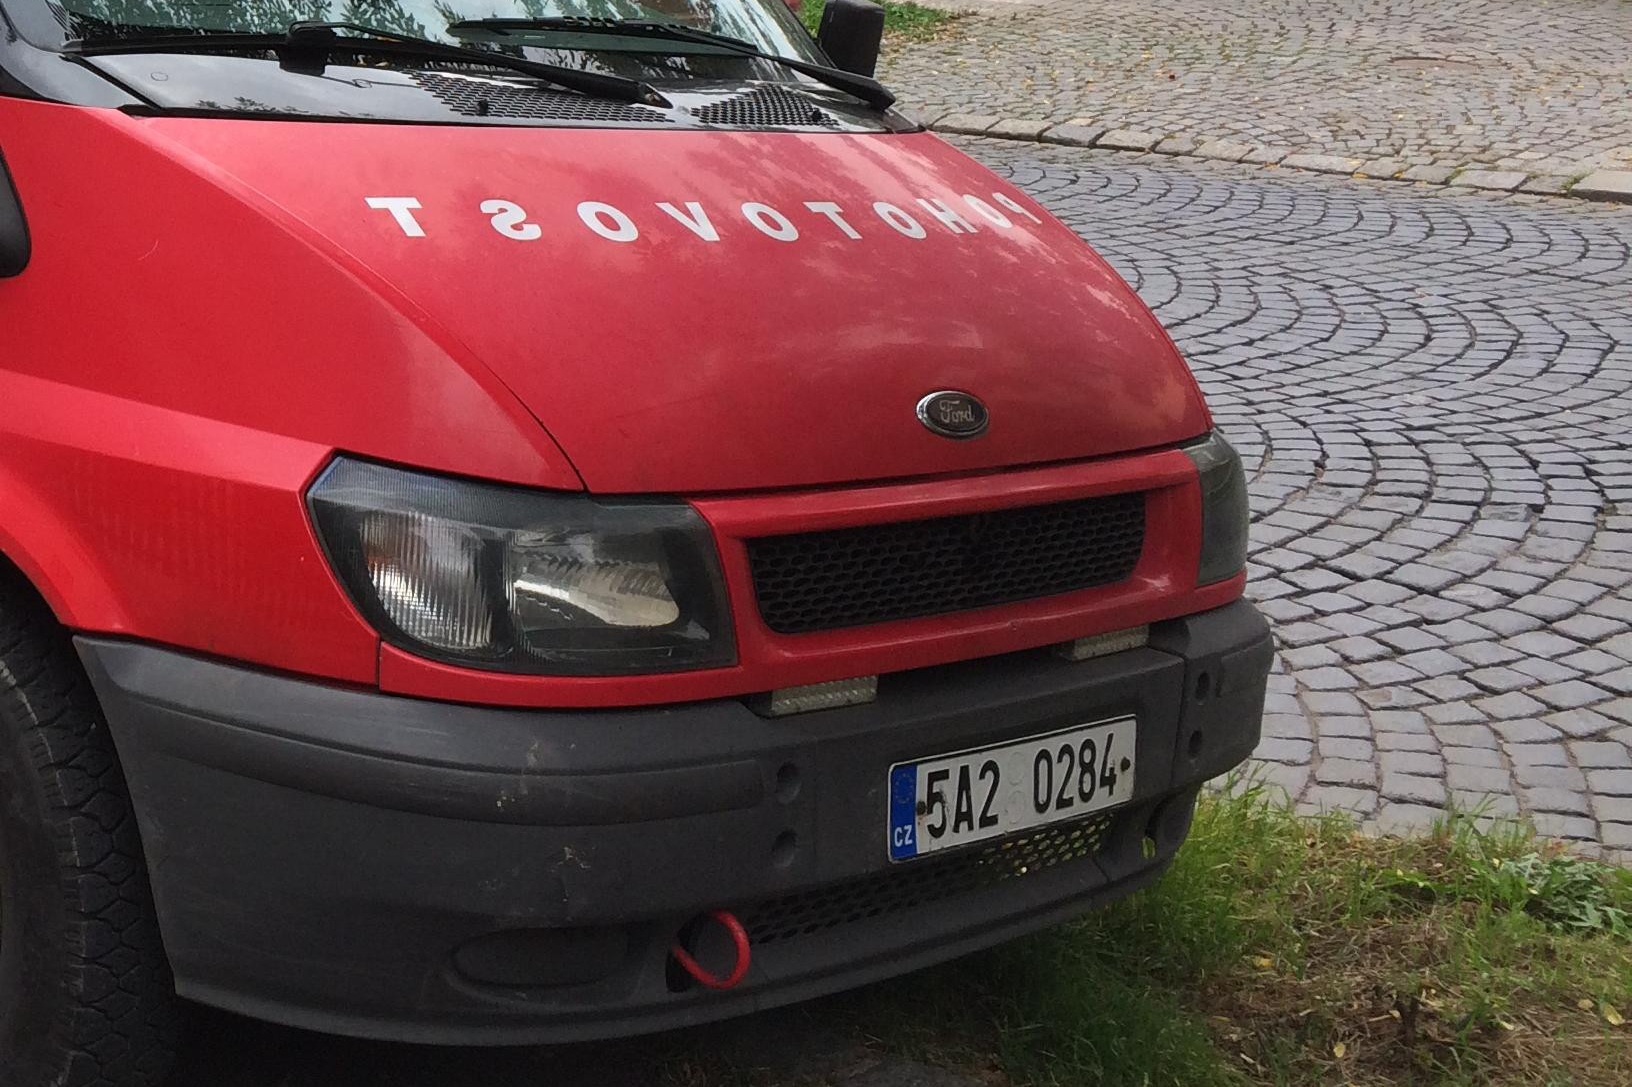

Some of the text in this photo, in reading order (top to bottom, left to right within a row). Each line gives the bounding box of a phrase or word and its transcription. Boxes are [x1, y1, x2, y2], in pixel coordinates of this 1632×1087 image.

[939, 399, 975, 424] Ford
[925, 732, 1118, 839] 5A2 0284
[894, 824, 913, 848] CZ
